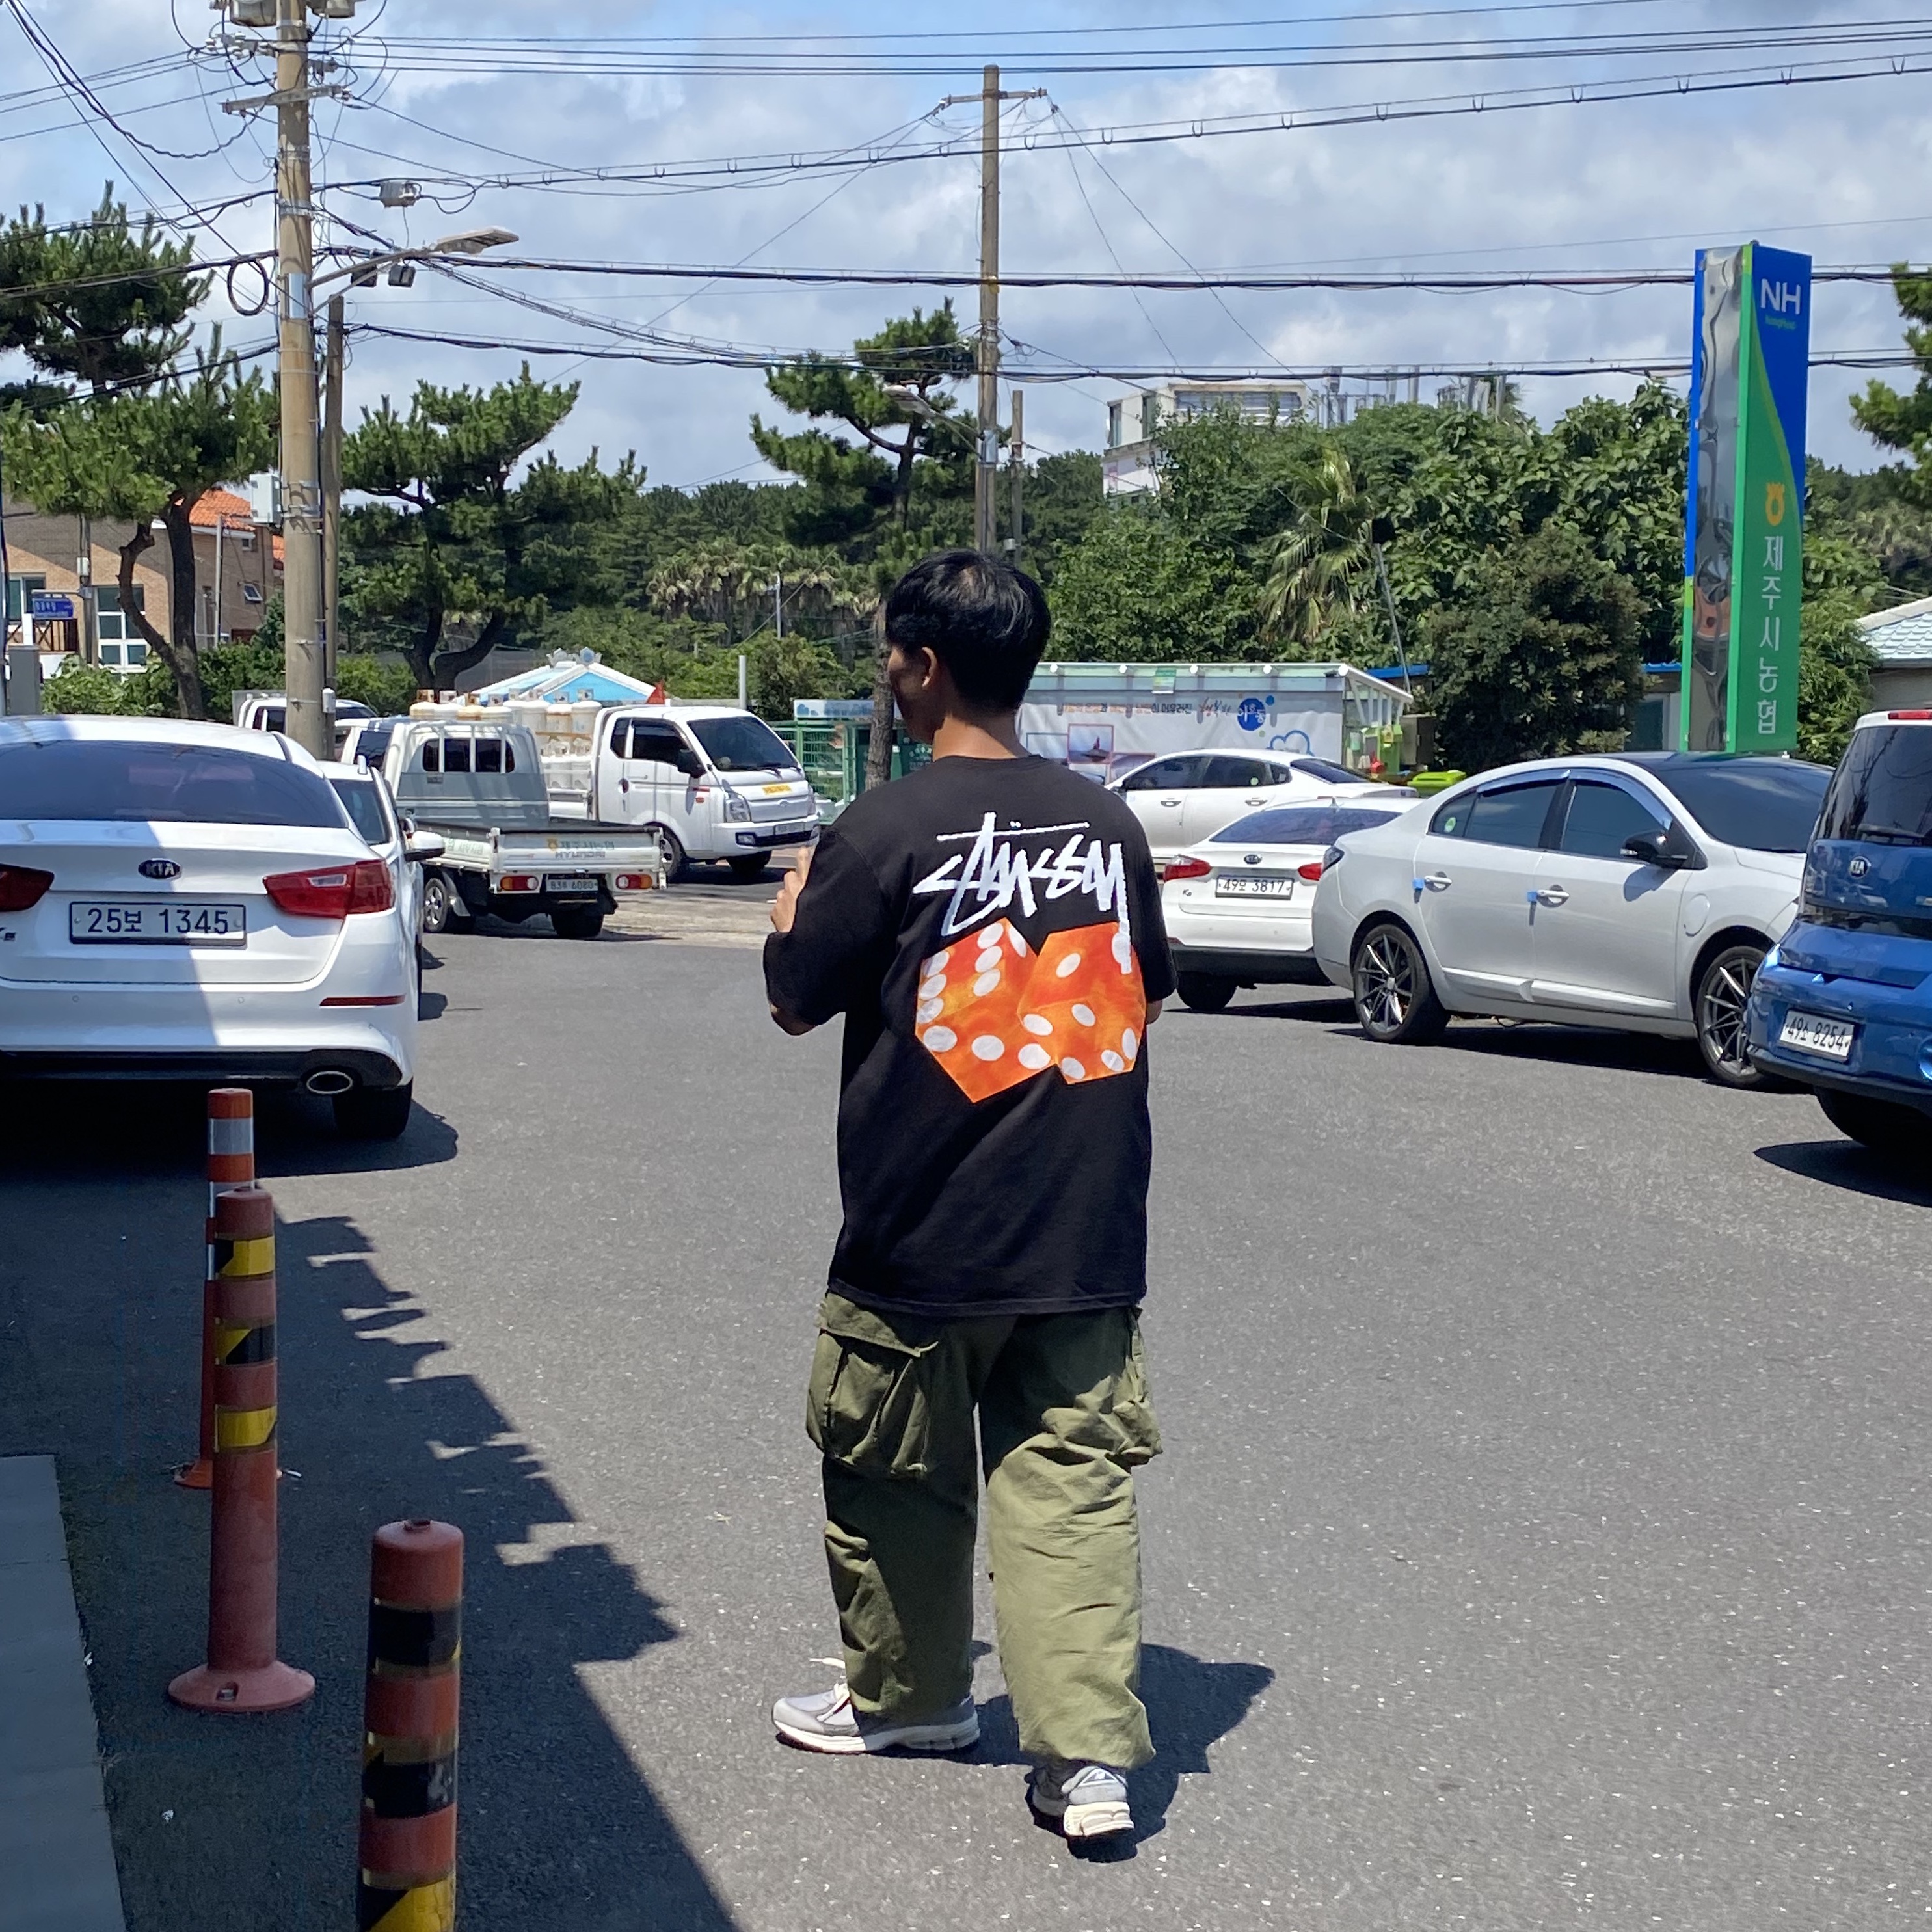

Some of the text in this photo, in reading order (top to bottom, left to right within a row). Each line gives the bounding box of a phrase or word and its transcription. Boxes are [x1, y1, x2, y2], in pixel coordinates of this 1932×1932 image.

[1760, 278, 1801, 315] NH
[1757, 535, 1784, 734] 제주시농협
[145, 863, 175, 876] KIA
[1222, 878, 1285, 893] 49모 3817
[87, 907, 229, 935] 25보 1345
[1812, 1021, 1847, 1051] 8254
